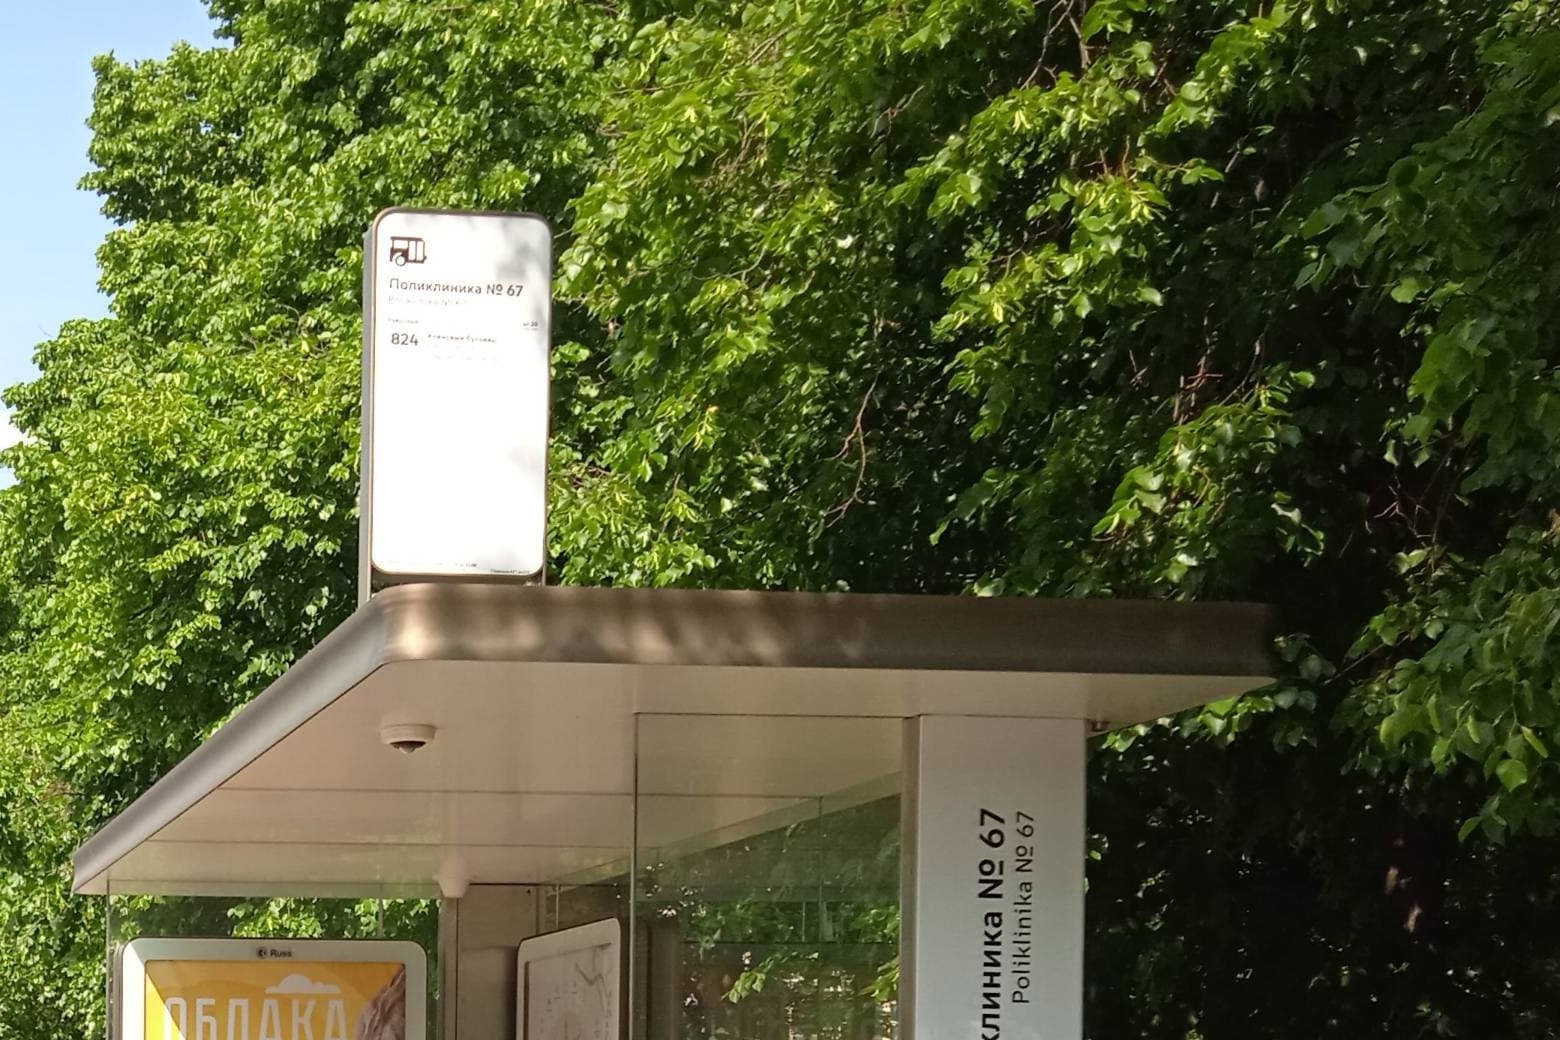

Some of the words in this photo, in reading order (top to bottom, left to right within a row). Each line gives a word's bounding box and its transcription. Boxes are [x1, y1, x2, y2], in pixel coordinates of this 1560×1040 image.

[389, 278, 482, 294] Поликлиника
[486, 284, 503, 296] №
[507, 285, 523, 297] 67
[391, 333, 419, 346] 824
[979, 808, 1006, 848] 67
[1017, 811, 1035, 837] 67
[978, 858, 1005, 899] №
[1012, 881, 1033, 1004] Poliklinika
